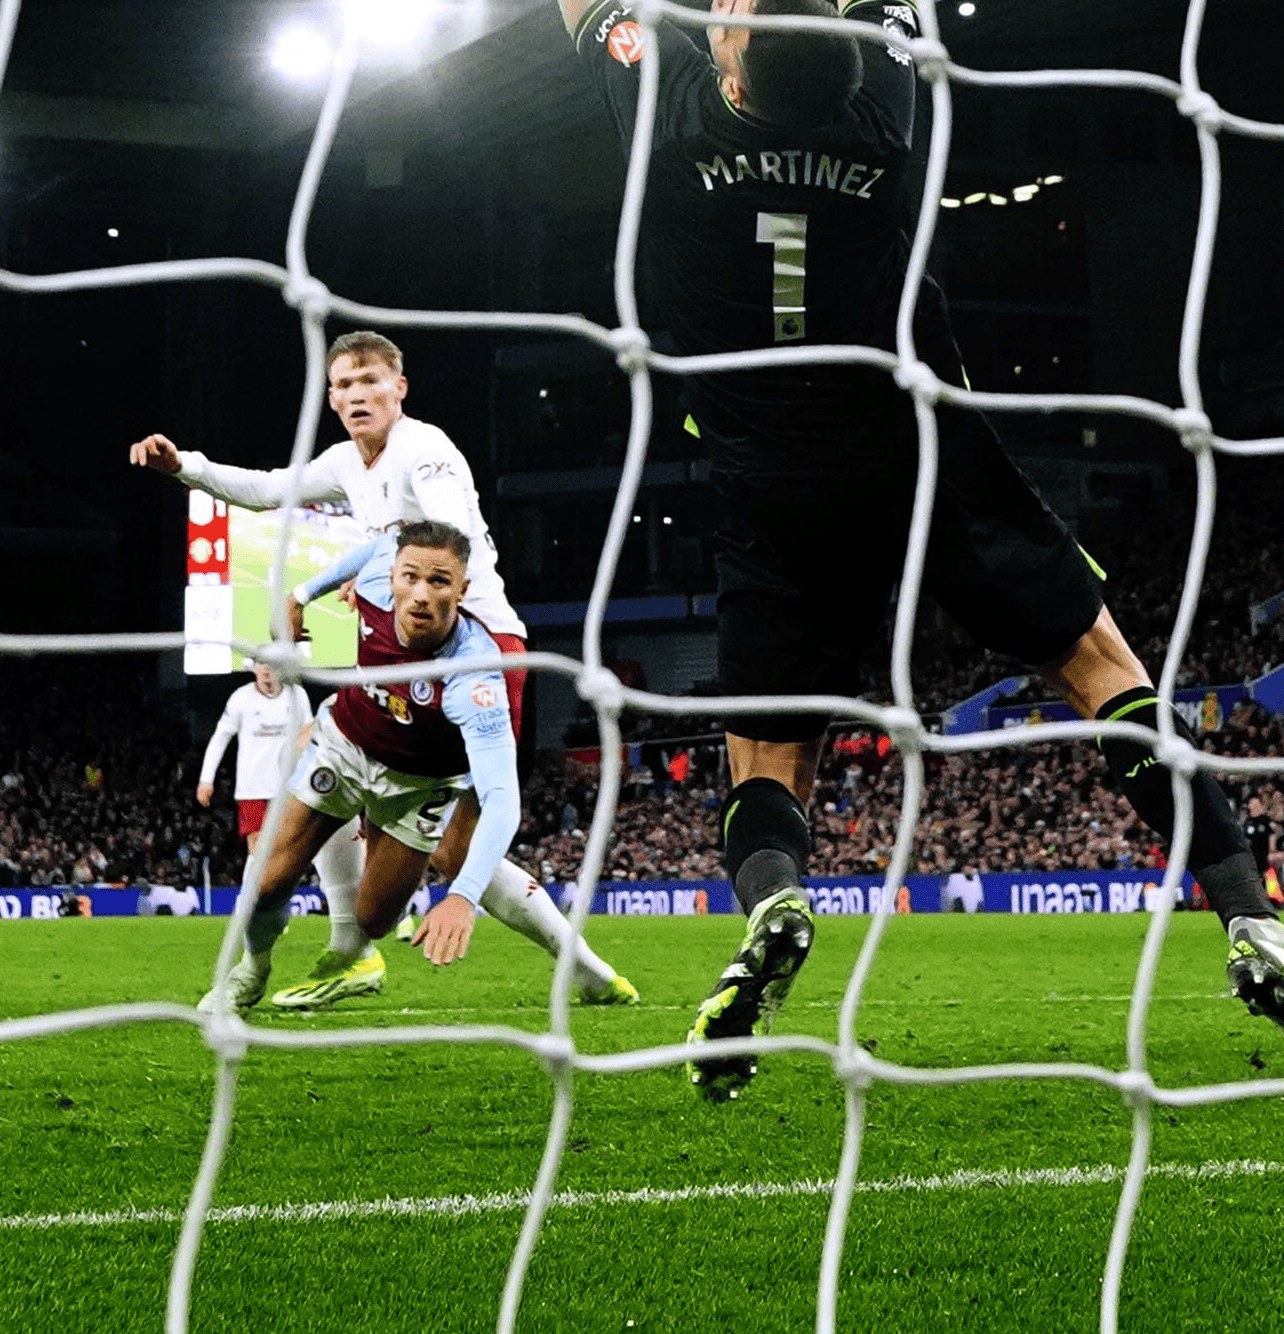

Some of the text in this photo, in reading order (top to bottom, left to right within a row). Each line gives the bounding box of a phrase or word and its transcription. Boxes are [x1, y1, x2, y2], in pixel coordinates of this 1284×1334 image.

[695, 150, 885, 199] MARTINEZ
[756, 212, 807, 342] 1
[417, 786, 454, 823] 2
[1109, 881, 1158, 913] BK
